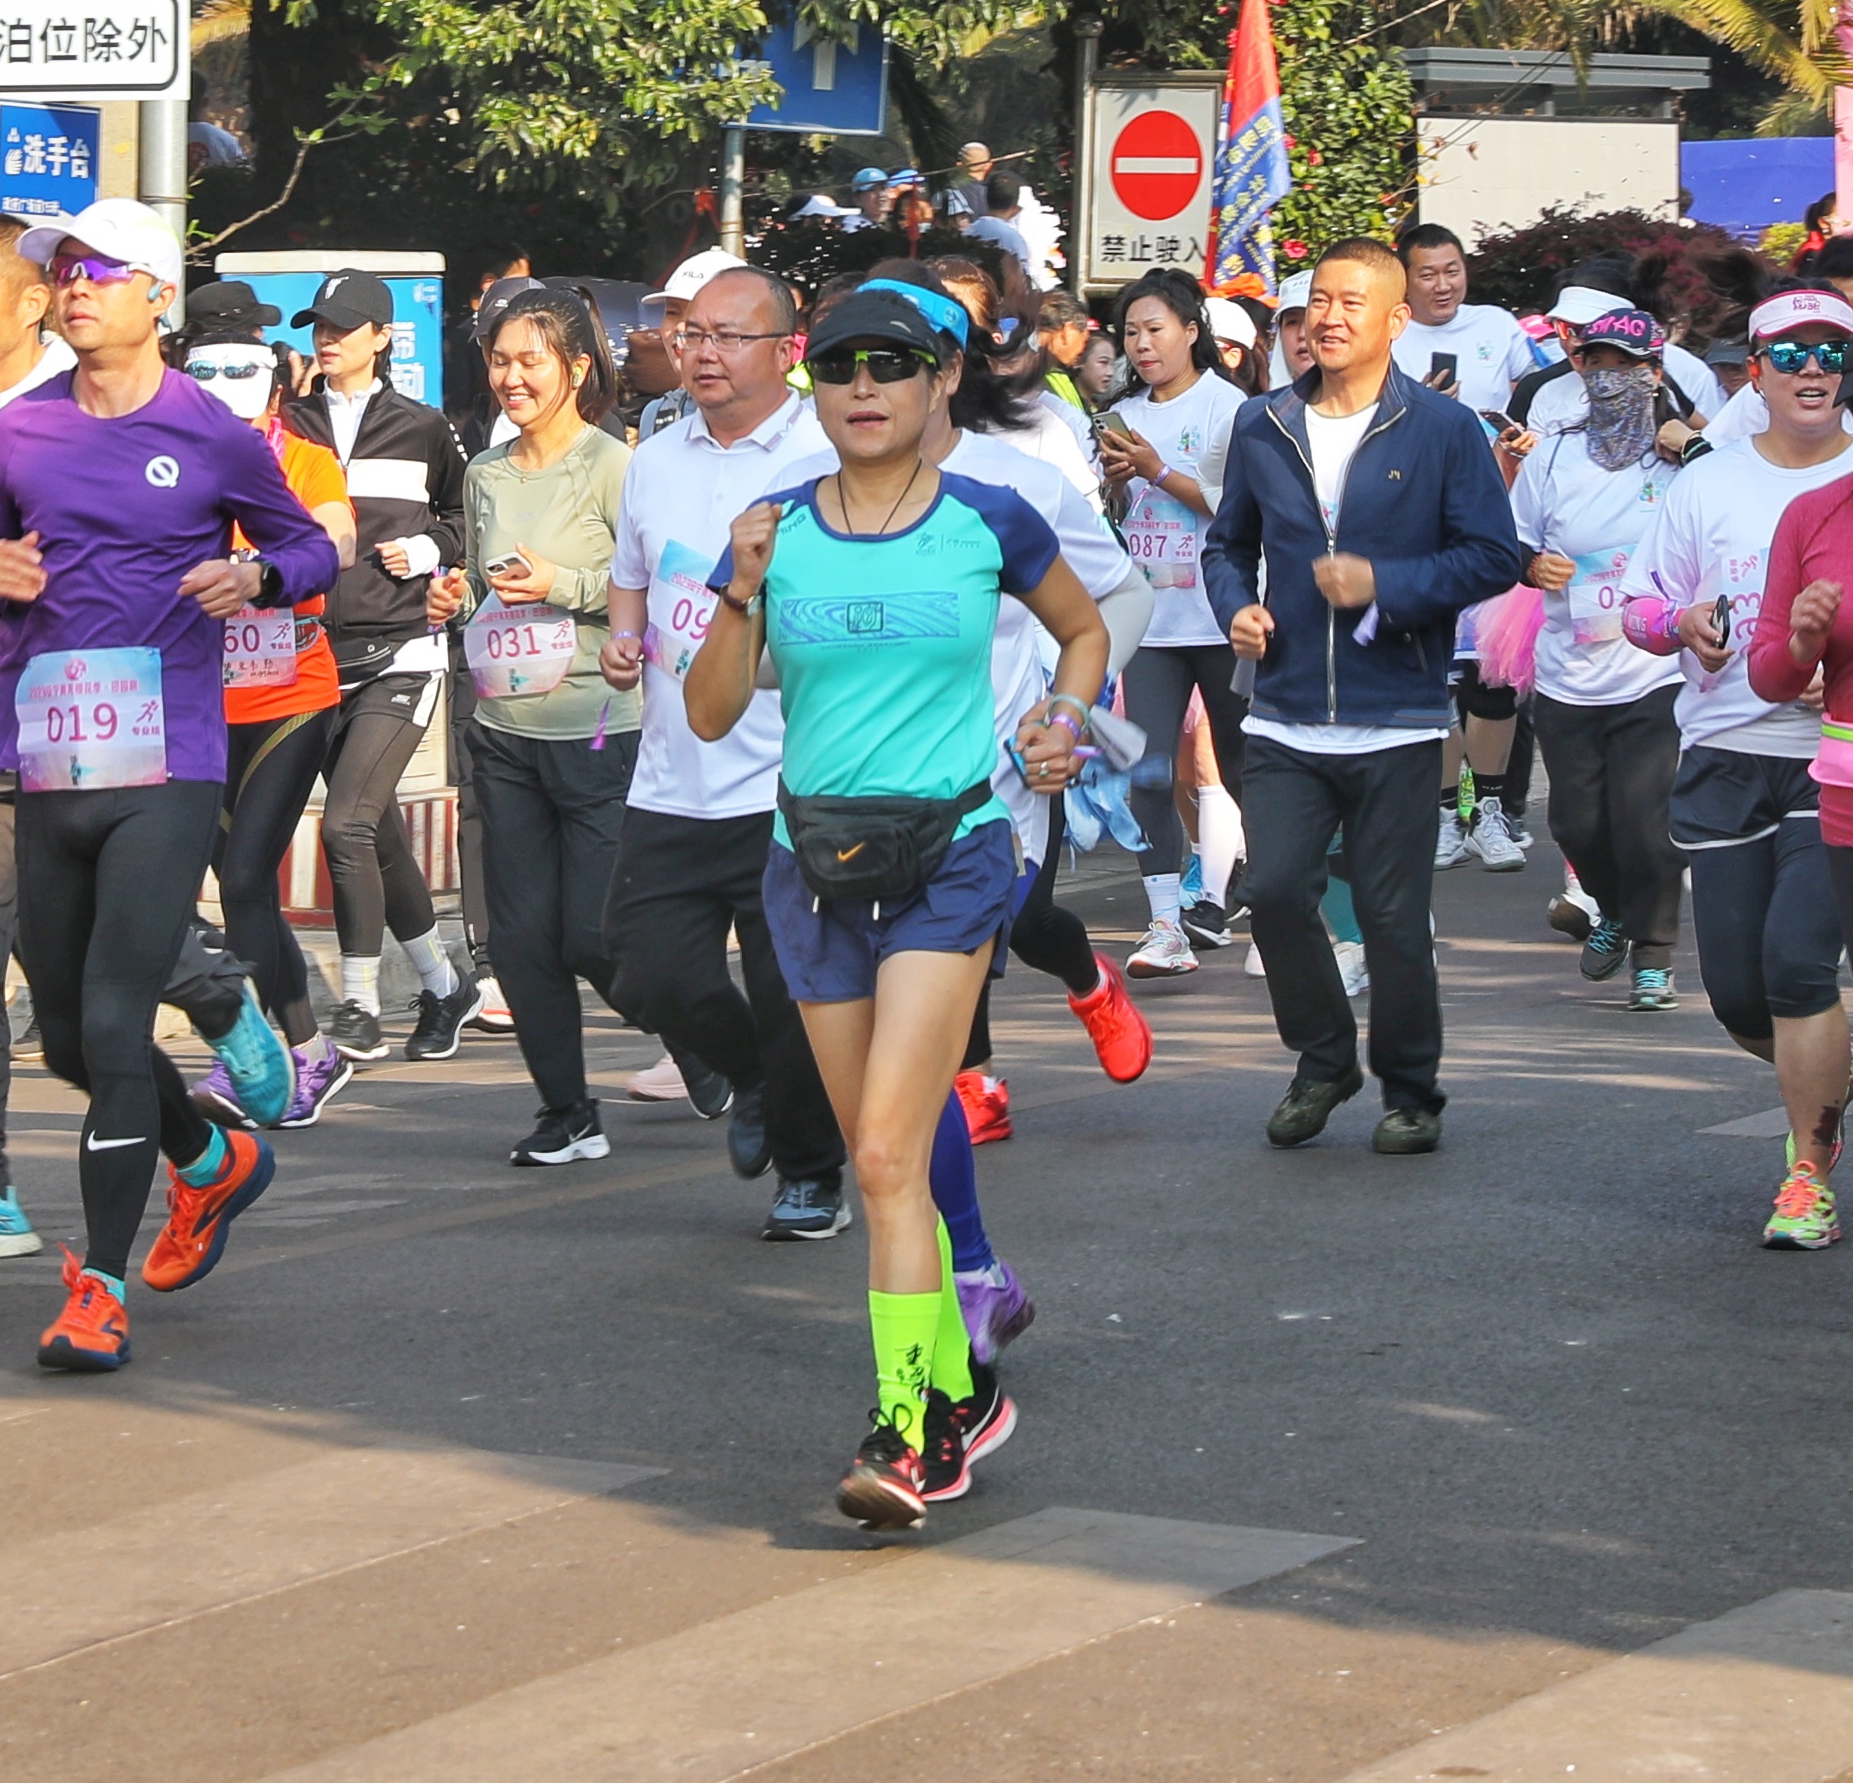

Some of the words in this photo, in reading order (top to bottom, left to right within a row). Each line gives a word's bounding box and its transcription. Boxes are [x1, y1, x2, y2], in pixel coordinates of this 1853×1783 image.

[23, 133, 91, 178] 洗手台
[1101, 234, 1206, 264] 禁止驶入
[1129, 533, 1168, 558] 087
[486, 625, 542, 660] 031
[47, 701, 119, 744] 019
[131, 725, 161, 736] 专业组
